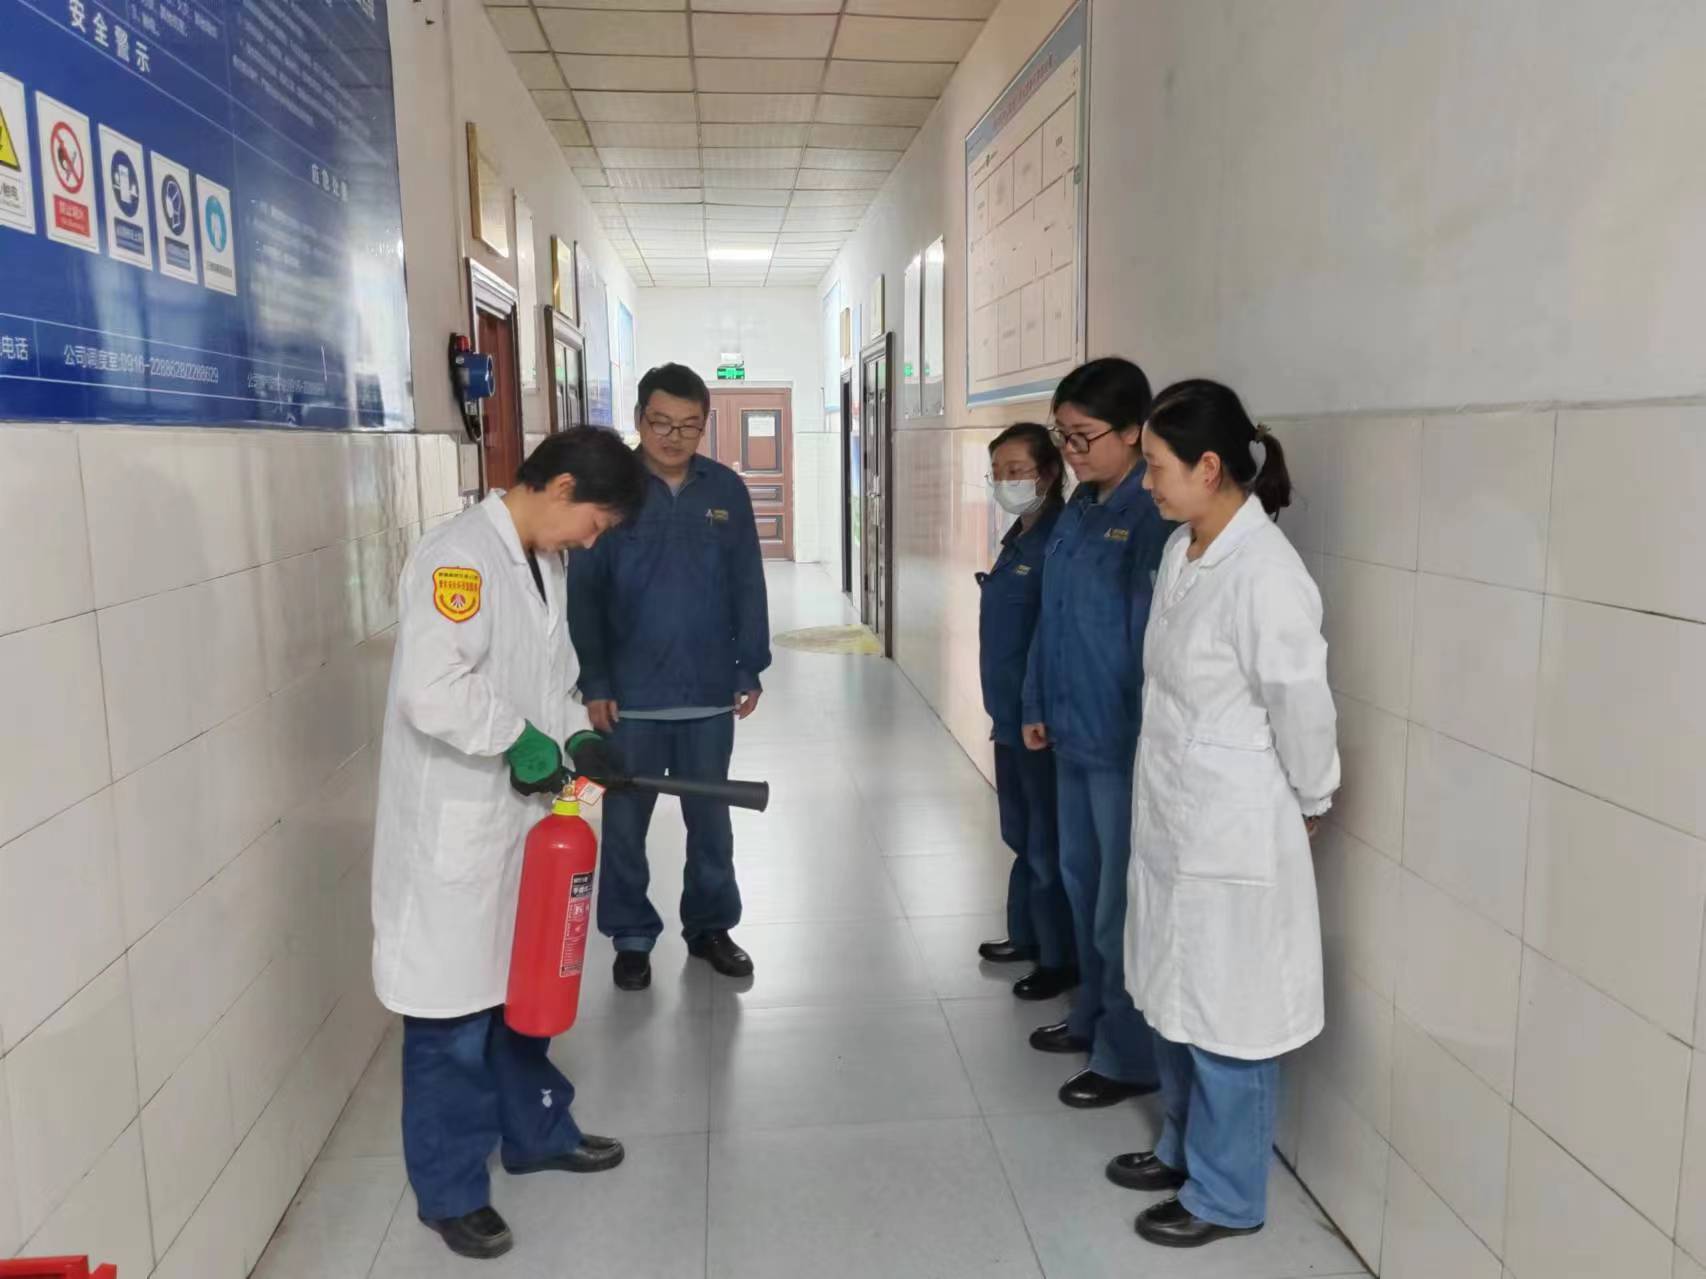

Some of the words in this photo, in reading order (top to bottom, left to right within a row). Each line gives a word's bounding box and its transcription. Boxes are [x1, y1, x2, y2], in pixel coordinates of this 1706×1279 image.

[69, 0, 150, 72] 安全警示
[0, 335, 29, 361] 电话
